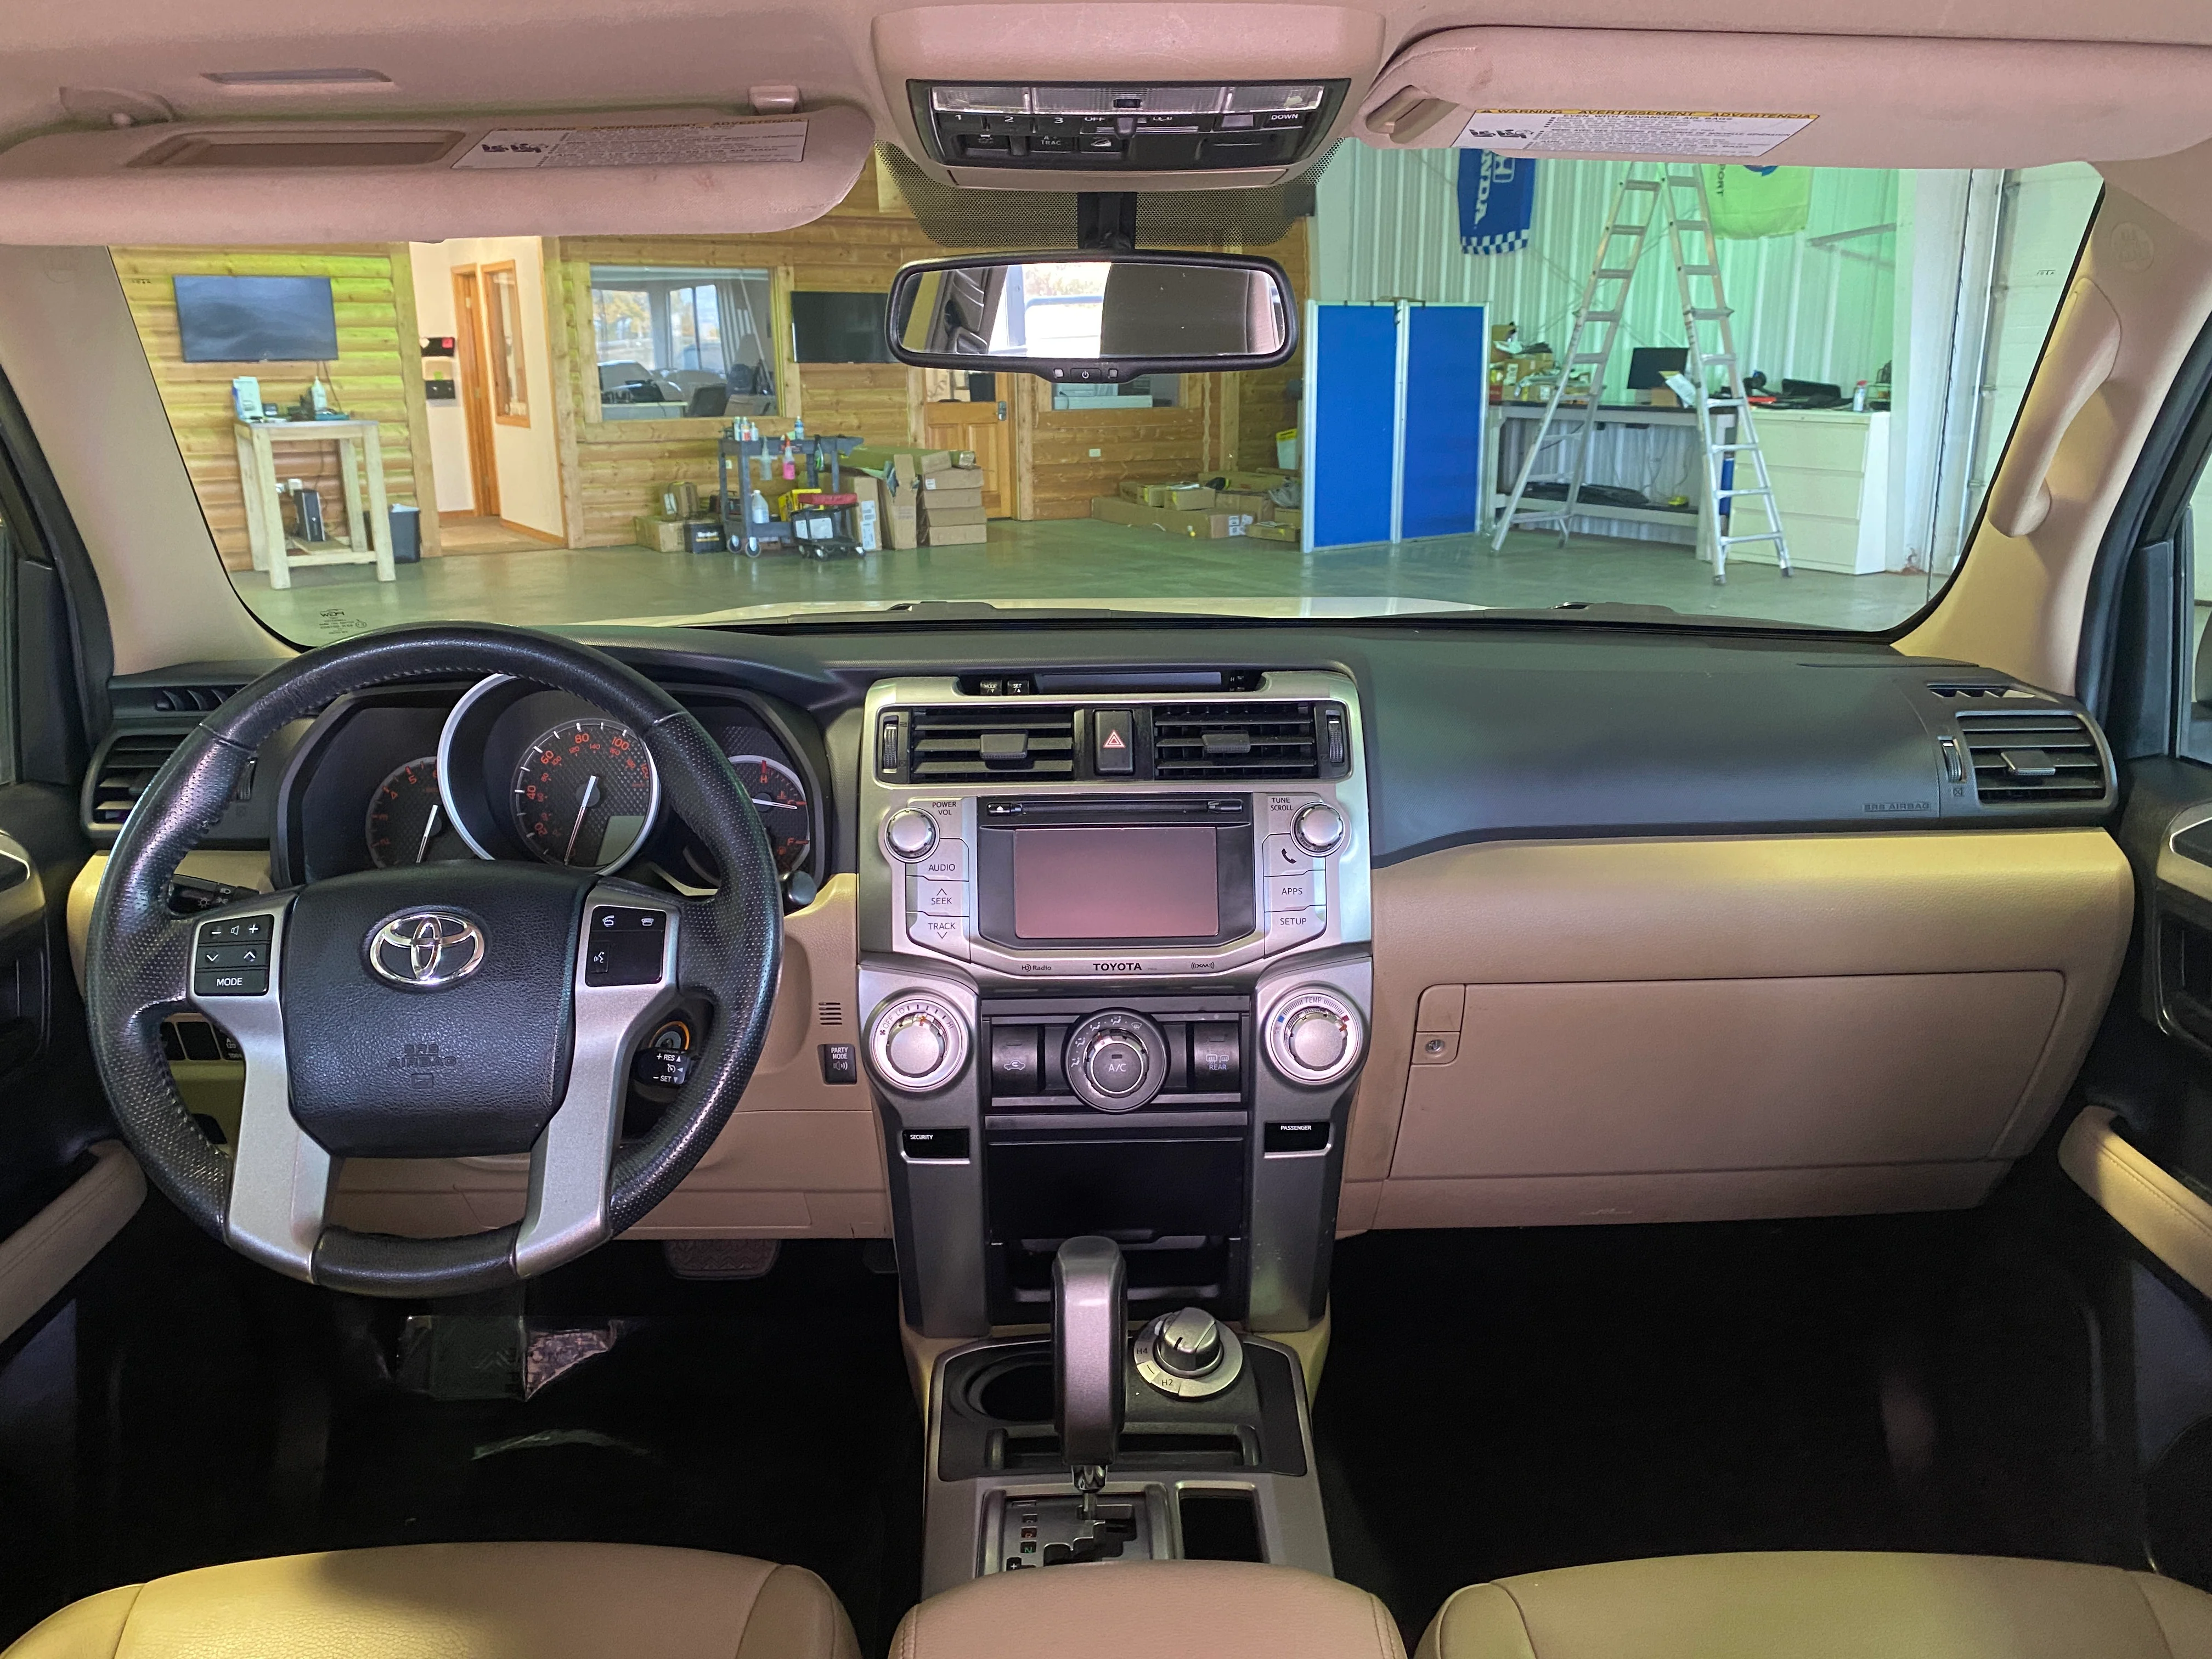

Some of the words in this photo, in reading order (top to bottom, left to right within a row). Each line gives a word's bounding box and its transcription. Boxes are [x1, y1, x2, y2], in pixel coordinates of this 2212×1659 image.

[575, 733, 590, 744] 80
[612, 736, 630, 751] 100
[540, 750, 554, 764] 60
[408, 775, 417, 785] 5
[760, 774, 768, 783] H
[390, 791, 398, 800] 4
[526, 785, 537, 800] 40
[1888, 802, 1929, 810] AIRBAG
[534, 822, 548, 836] 20
[787, 837, 795, 846] F
[928, 864, 956, 872] AUDIO
[1282, 887, 1303, 895] APPS
[1280, 917, 1307, 926] SETUP
[1092, 963, 1142, 971] TOYOTA
[216, 978, 243, 986] MODE
[895, 1007, 905, 1016] LO
[882, 1015, 893, 1029] OFF
[946, 1020, 955, 1029] HI
[1108, 1063, 1127, 1072] A/C
[1161, 1379, 1173, 1387] H2
